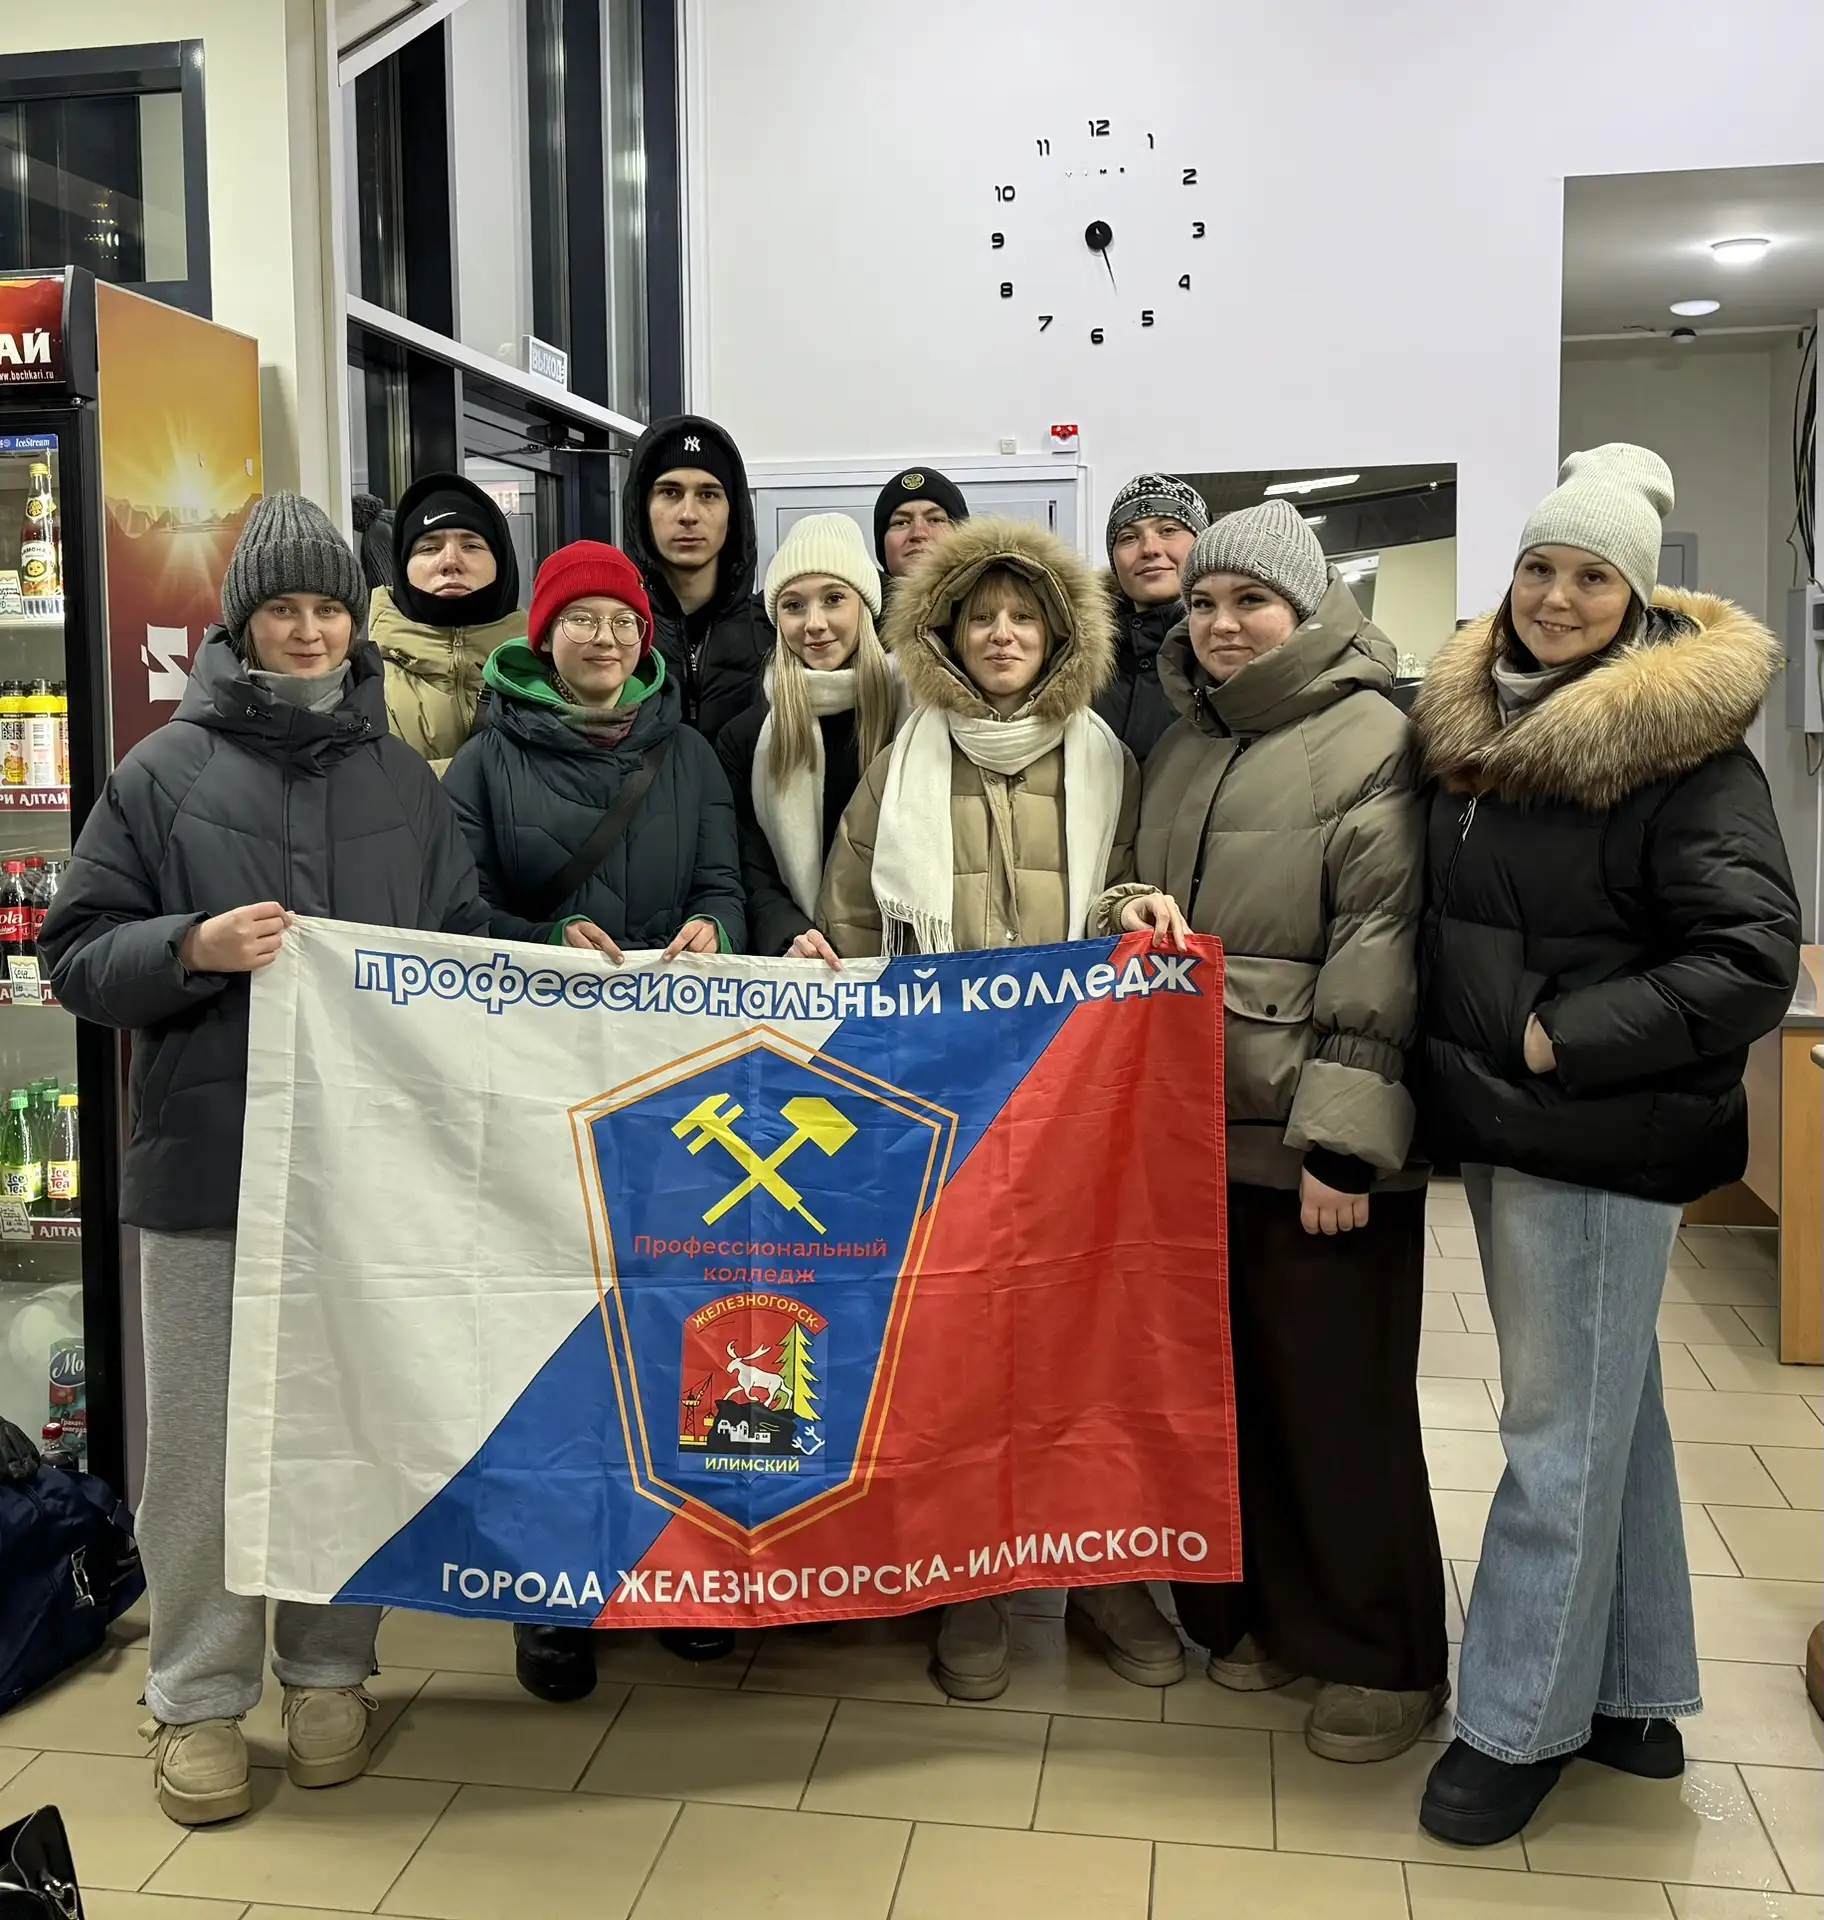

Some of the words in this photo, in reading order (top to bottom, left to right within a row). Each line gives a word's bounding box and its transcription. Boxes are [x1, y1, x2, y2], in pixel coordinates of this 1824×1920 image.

[1088, 119, 1110, 137] 12
[1036, 139, 1051, 156] 11
[1147, 133, 1155, 149] 1
[1182, 168, 1198, 185] 2
[995, 185, 1016, 202] 10
[1192, 222, 1206, 238] 3
[991, 232, 1005, 249] 9
[1000, 281, 1013, 298] 8
[1178, 273, 1191, 290] 4
[1038, 315, 1054, 332] 7
[1141, 310, 1154, 327] 5
[1090, 328, 1104, 345] 6
[532, 347, 563, 383] ВЫХОД
[15, 437, 50, 448] IceStream
[683, 435, 701, 452] NY
[20, 791, 69, 807] АЛТАЙ
[355, 948, 941, 1020] профессиональный
[961, 953, 1204, 1012] колледж
[8, 1173, 25, 1183] Ice
[51, 1167, 70, 1178] Ice
[7, 1183, 28, 1194] Tea
[51, 1178, 70, 1189] Tea
[39, 1225, 81, 1238] АЛТА
[632, 1234, 889, 1258] Профессиональный
[703, 1267, 816, 1285] колледж
[691, 1294, 820, 1329] ЖЕЛЕЗНОГОРСК-
[704, 1456, 800, 1473] ИЛИМСКИЙ
[442, 1562, 605, 1608] ГОРОДА
[616, 1525, 1209, 1606] ЖЕЛЕЗНОГОРСКА-ИЛИМСКОГО
